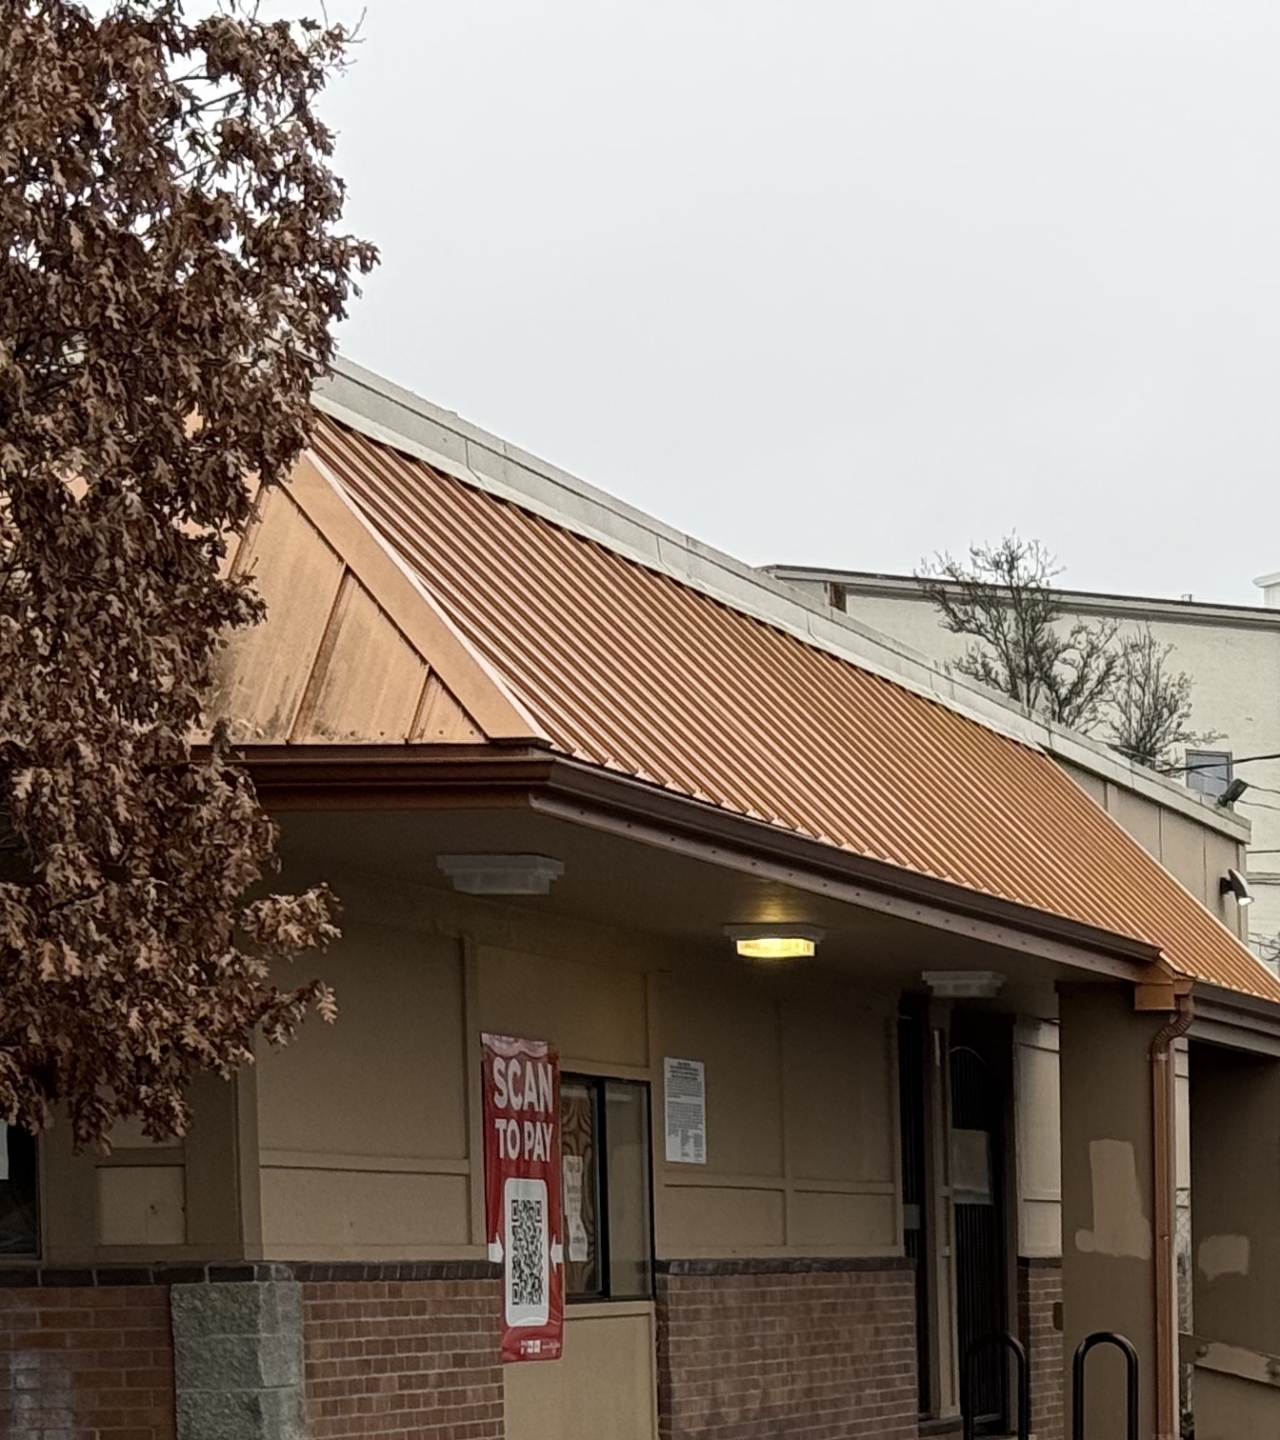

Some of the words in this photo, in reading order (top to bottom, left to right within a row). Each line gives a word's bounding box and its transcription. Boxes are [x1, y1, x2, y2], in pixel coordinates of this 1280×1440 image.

[492, 1056, 553, 1113] SCAN
[494, 1117, 520, 1160] TO
[524, 1120, 554, 1163] PAY
